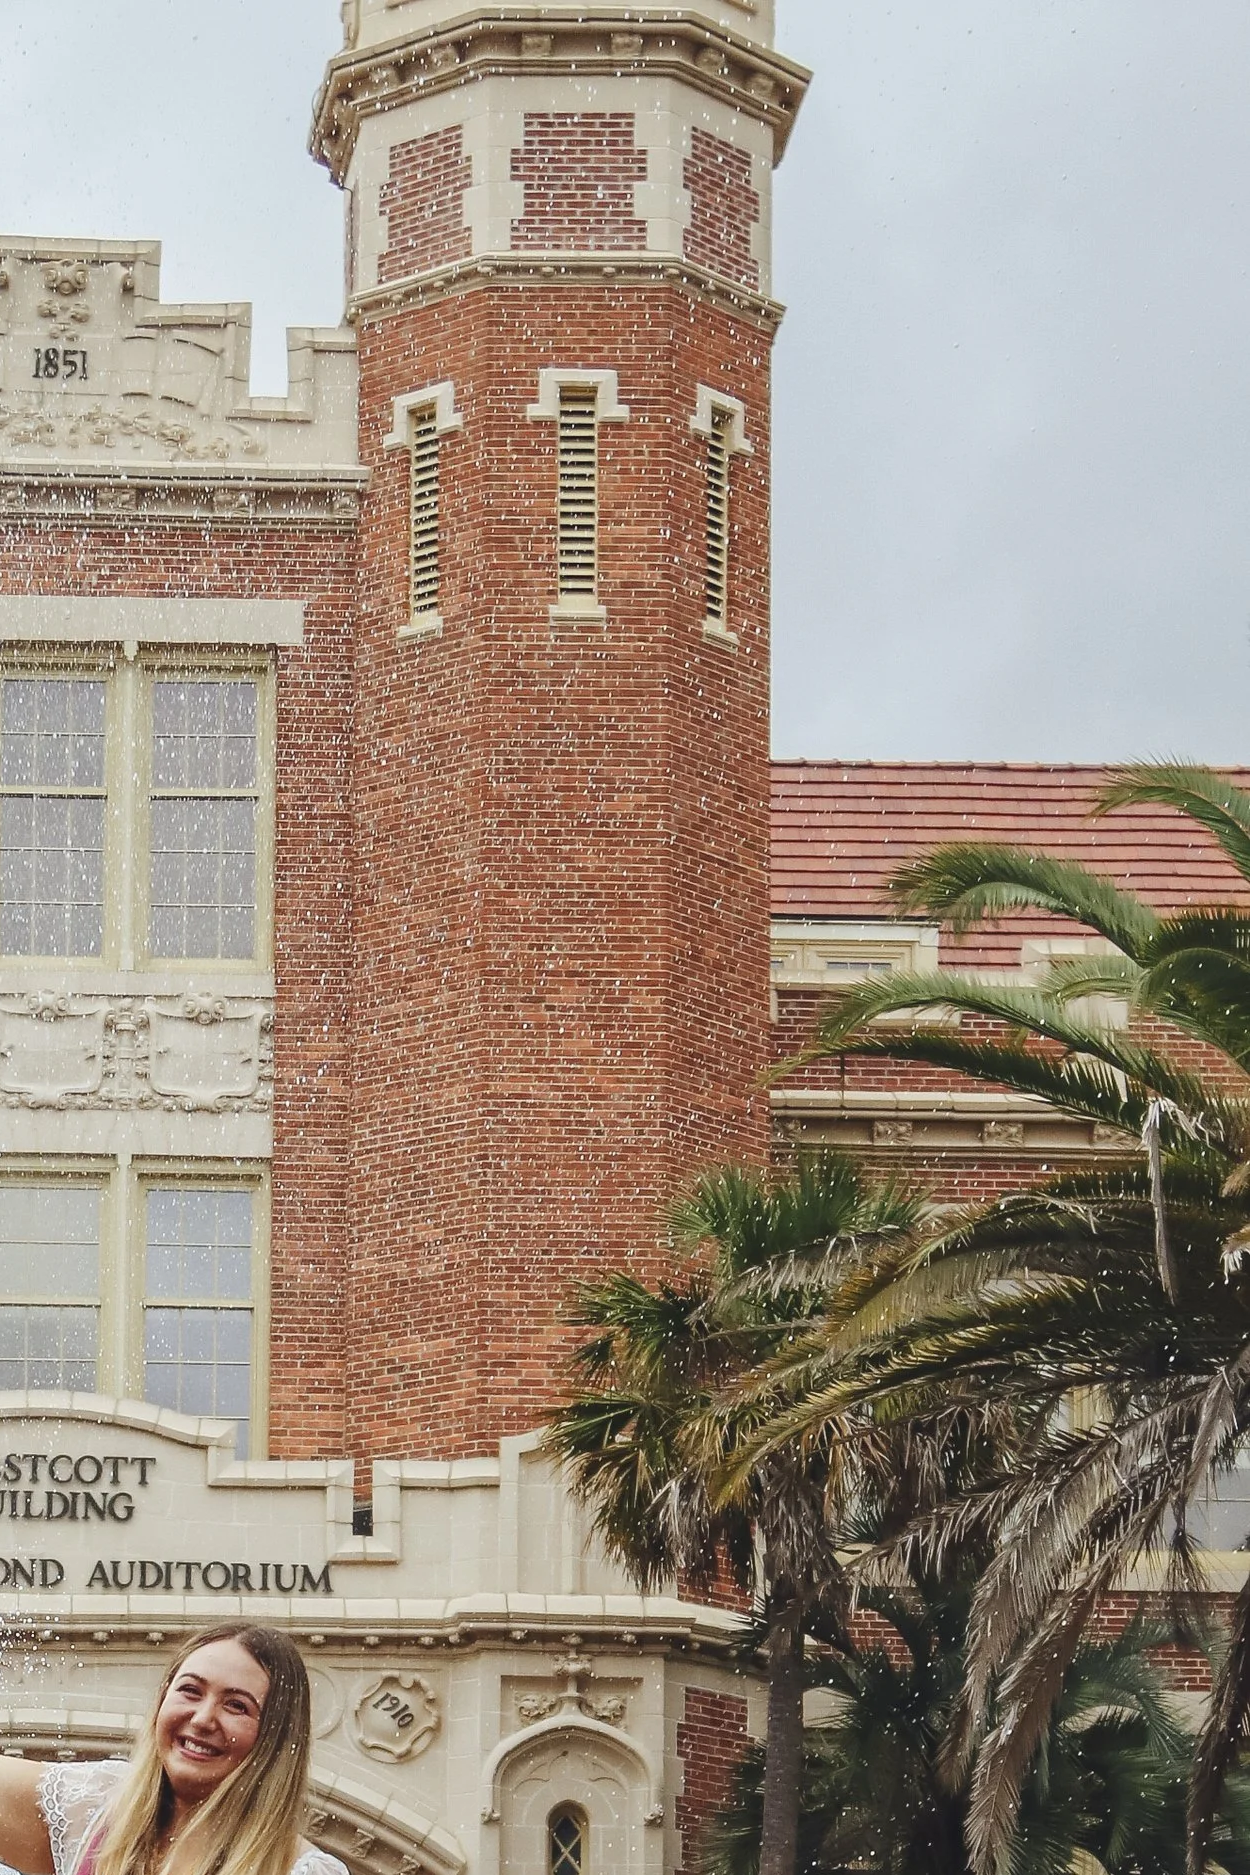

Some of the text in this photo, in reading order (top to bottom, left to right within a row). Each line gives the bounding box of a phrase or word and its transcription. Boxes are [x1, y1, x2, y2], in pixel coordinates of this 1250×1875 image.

[32, 347, 88, 380] 1851
[86, 1559, 334, 1594] AUDITORIUM
[372, 1692, 414, 1727] 1910
